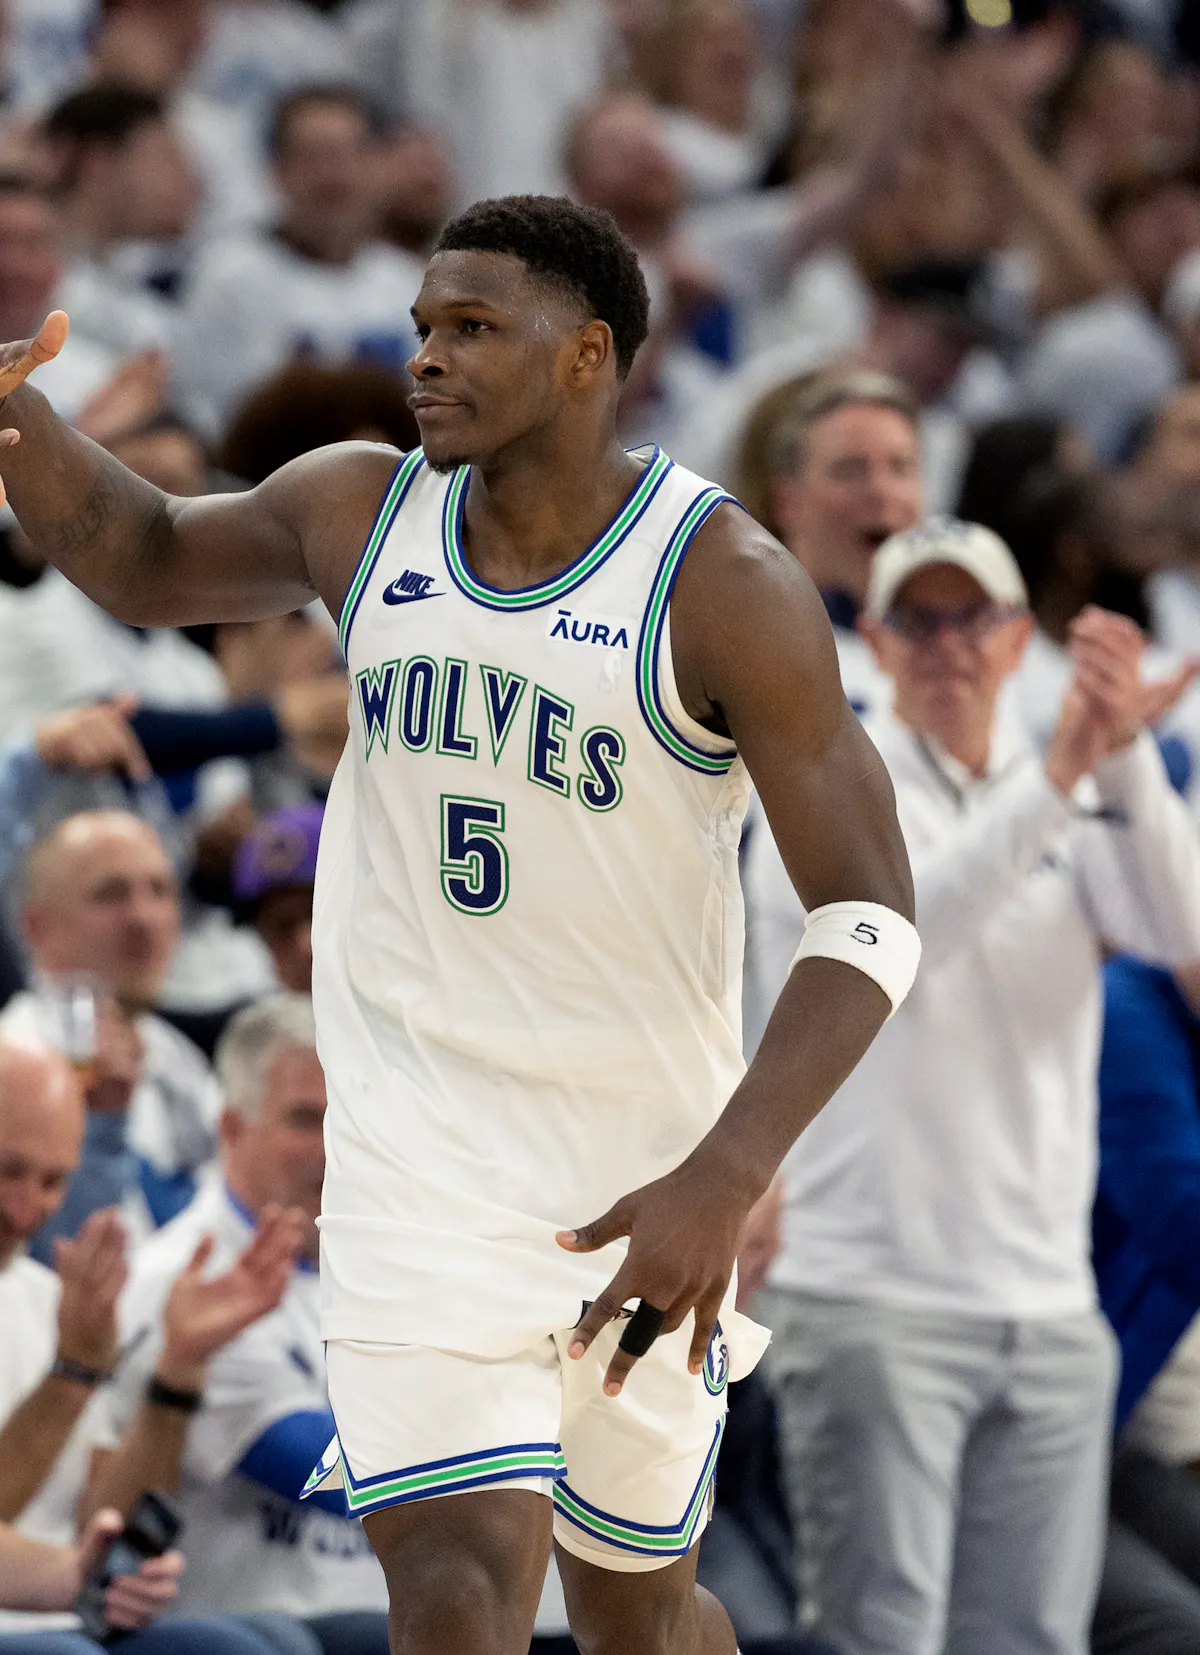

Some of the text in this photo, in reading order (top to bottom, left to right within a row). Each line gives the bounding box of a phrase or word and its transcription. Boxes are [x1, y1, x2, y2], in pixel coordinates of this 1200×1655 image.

[394, 569, 436, 597] NIKE
[356, 655, 626, 813] WOLVES
[440, 793, 509, 917] 5
[850, 922, 880, 946] 5
